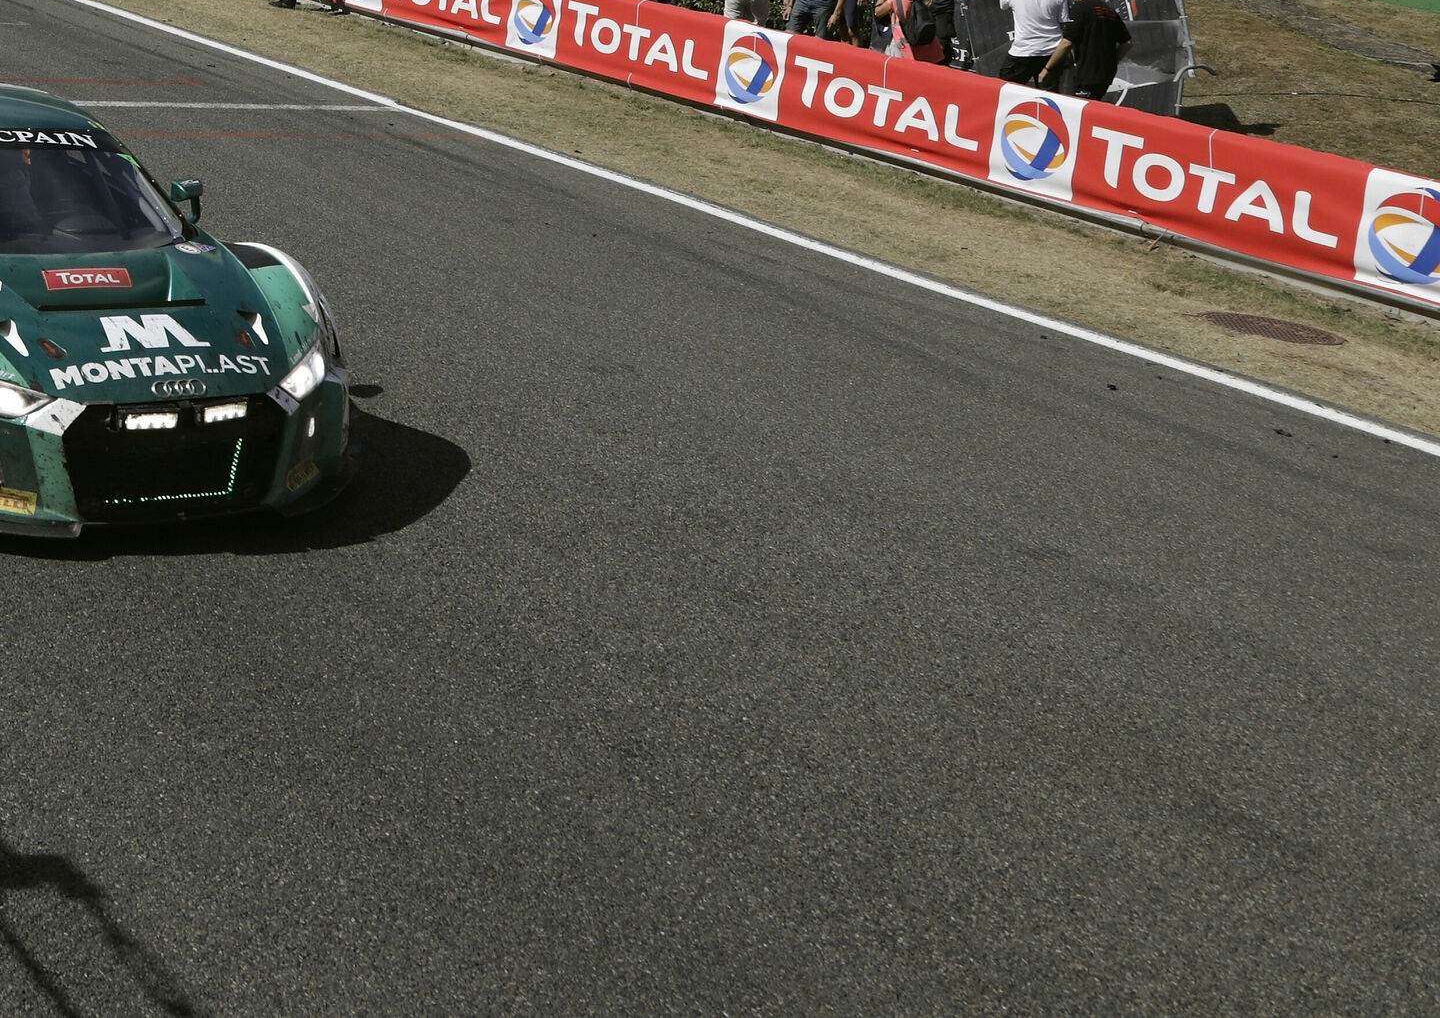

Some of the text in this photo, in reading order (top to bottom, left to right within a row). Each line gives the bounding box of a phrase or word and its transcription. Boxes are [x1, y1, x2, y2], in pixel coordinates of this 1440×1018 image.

[567, 0, 709, 80] TOTAL
[794, 55, 979, 152] TOTAL
[1091, 126, 1338, 249] TOTAL
[55, 271, 120, 285] TOTAL
[49, 354, 272, 391] MONTAPLAST
